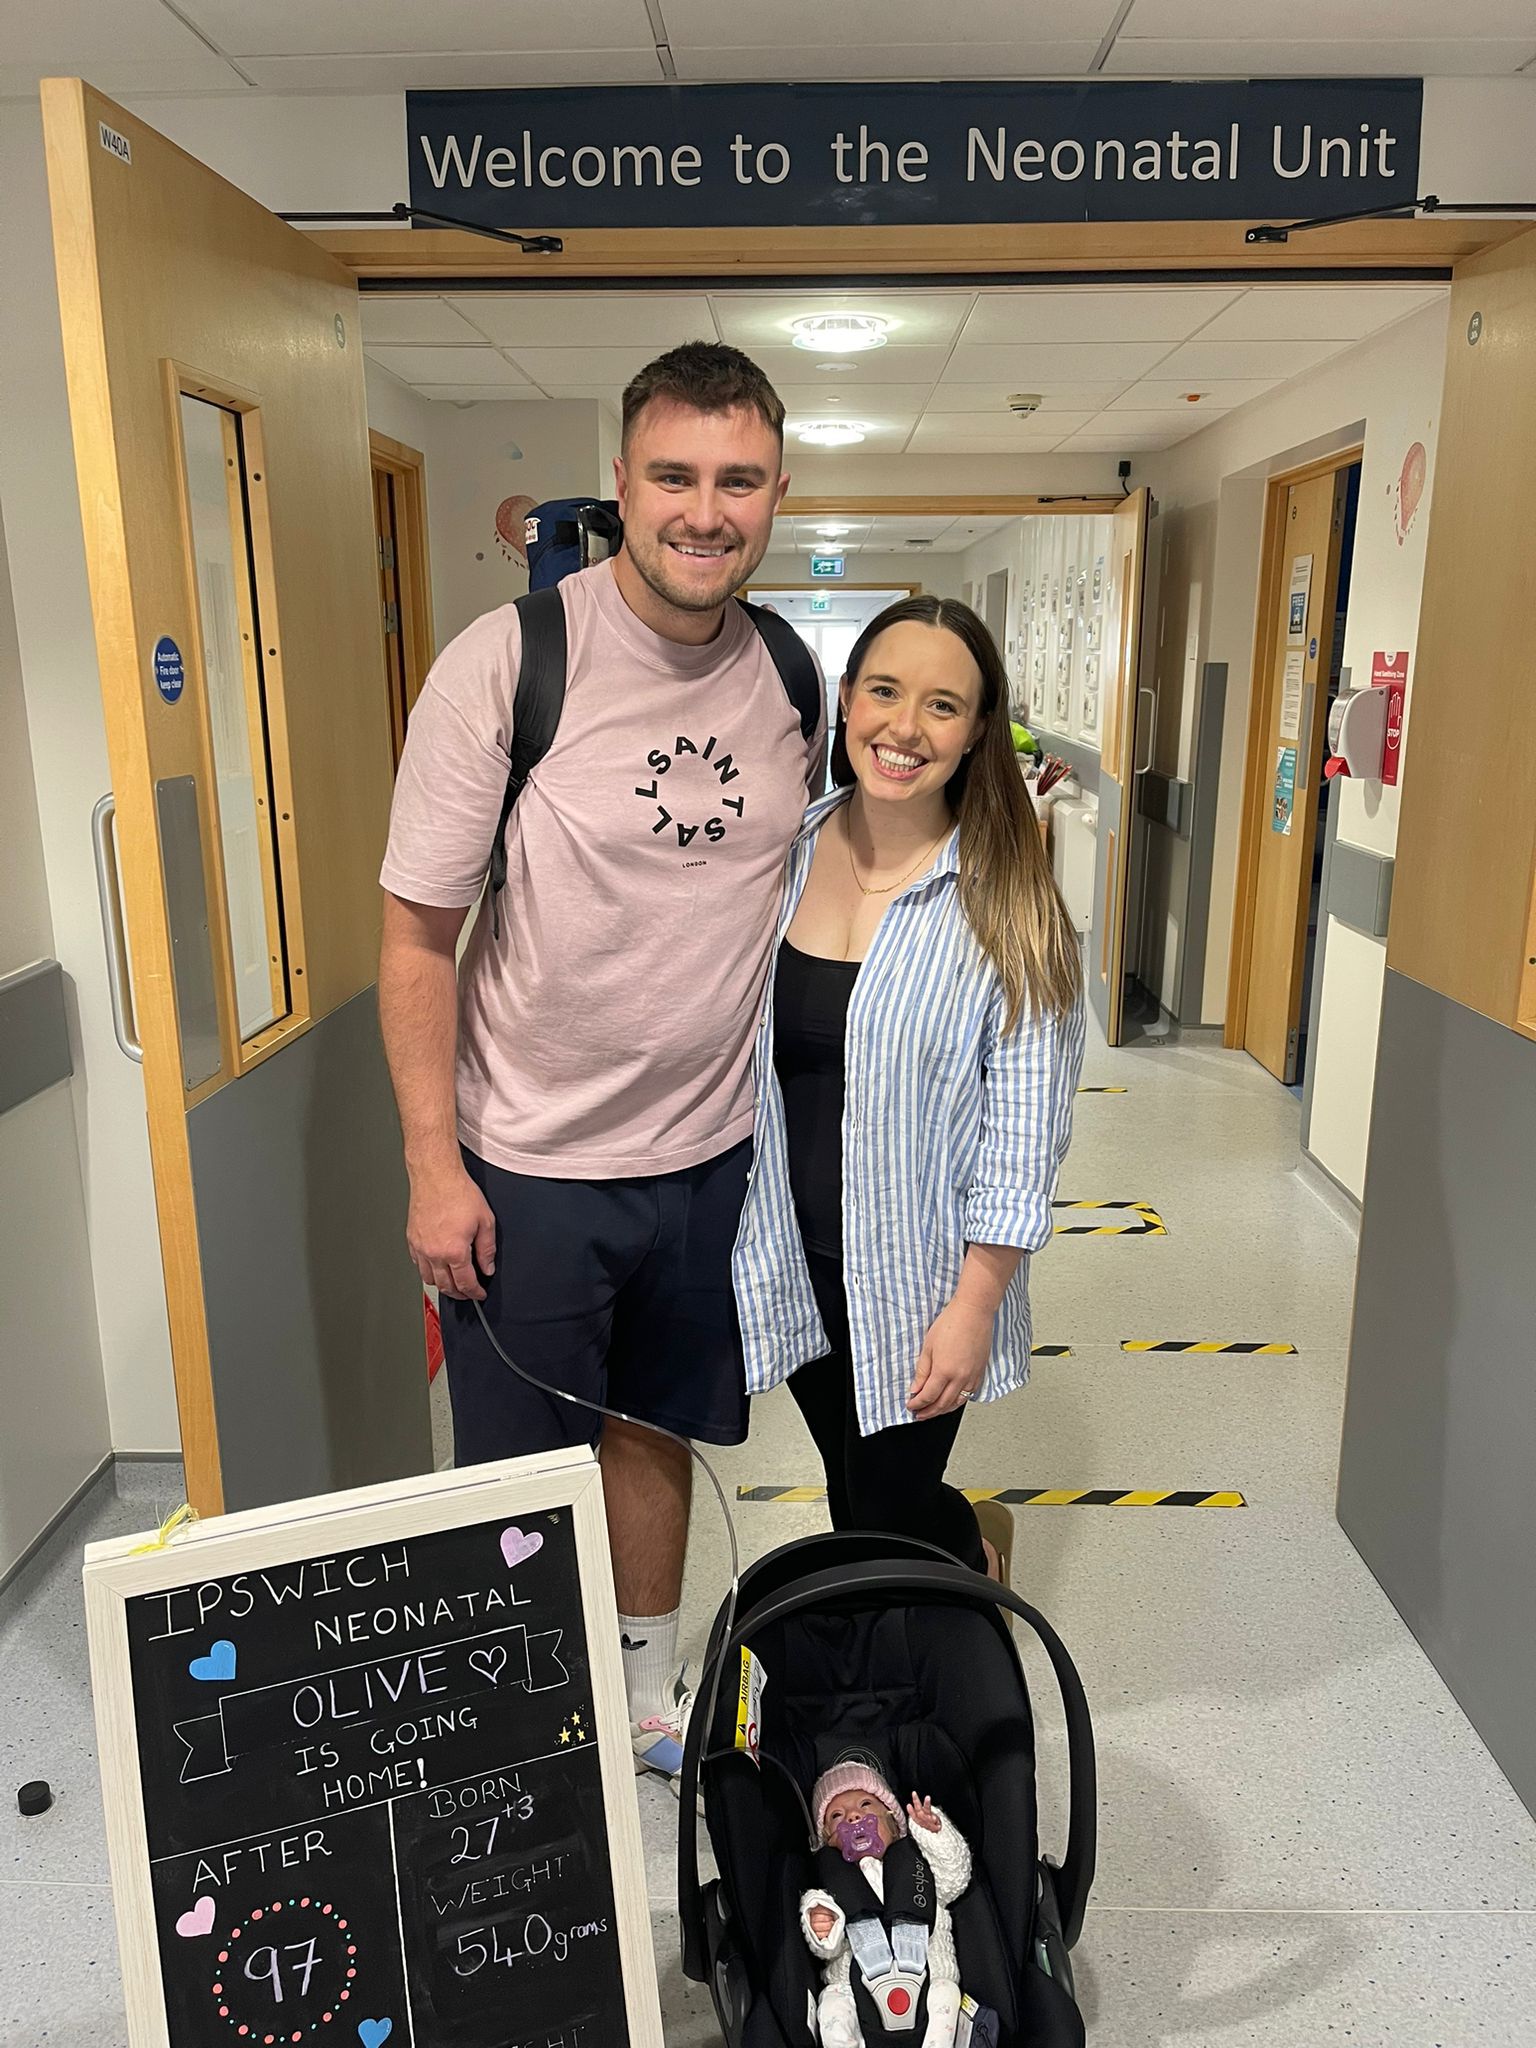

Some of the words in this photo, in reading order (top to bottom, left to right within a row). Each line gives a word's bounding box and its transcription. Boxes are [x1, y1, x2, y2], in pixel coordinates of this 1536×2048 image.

[101, 126, 130, 161] W40A
[420, 130, 702, 188] Welcome
[729, 134, 791, 185] to
[830, 124, 929, 183] the
[967, 122, 1239, 182] Neonatal
[1272, 123, 1397, 179] Unit
[160, 666, 169, 675] Fire
[169, 665, 179, 675] door
[1387, 728, 1400, 738] STOP
[682, 860, 707, 868] LONDON
[144, 1546, 411, 1642] IPSWICH
[314, 1584, 532, 1651] NEONATAL
[293, 1650, 448, 1728] OLIVE
[741, 1659, 750, 1706] AIRBAG
[295, 1742, 340, 1776] IS
[370, 1707, 478, 1755] GOING
[323, 1757, 428, 1808] HOME!
[427, 1772, 522, 1819] BORN
[192, 1830, 333, 1893] AFTER
[431, 1853, 570, 1916] WEIGHT
[244, 1937, 324, 2004] 97
